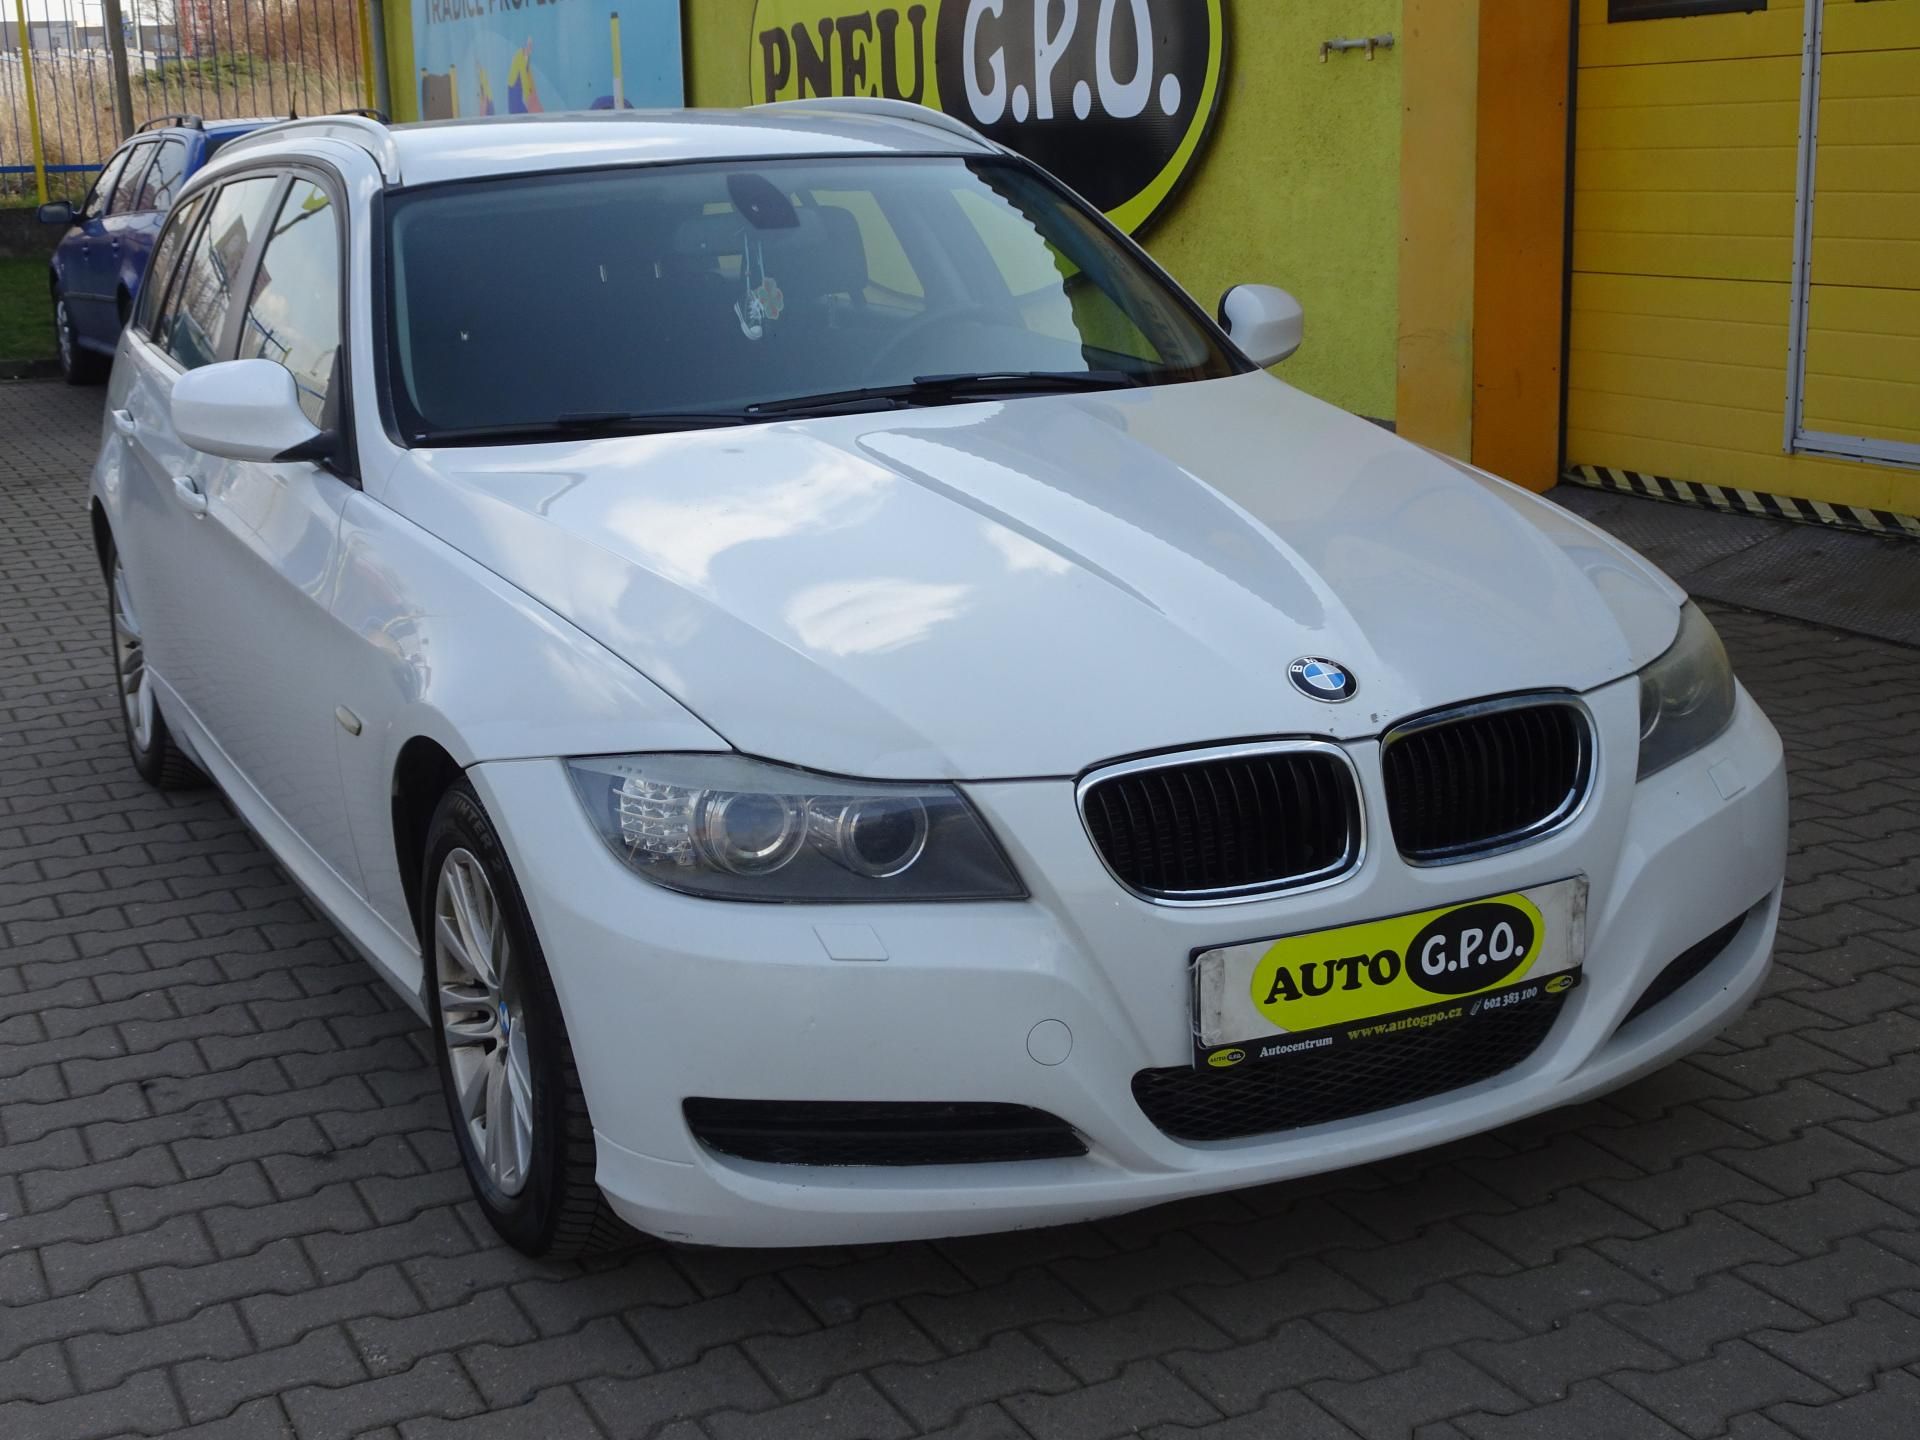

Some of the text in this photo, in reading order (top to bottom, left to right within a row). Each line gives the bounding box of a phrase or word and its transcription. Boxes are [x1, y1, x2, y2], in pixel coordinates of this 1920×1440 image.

[759, 0, 1181, 125] PNEU G.P.O.
[1263, 921, 1524, 1005] AUTO G.P.O.
[1259, 1036, 1333, 1058] Autocentrum
[1347, 1007, 1463, 1040] www.autogpo.cz
[1483, 996, 1501, 1010] 602
[1521, 986, 1538, 1000] 100
